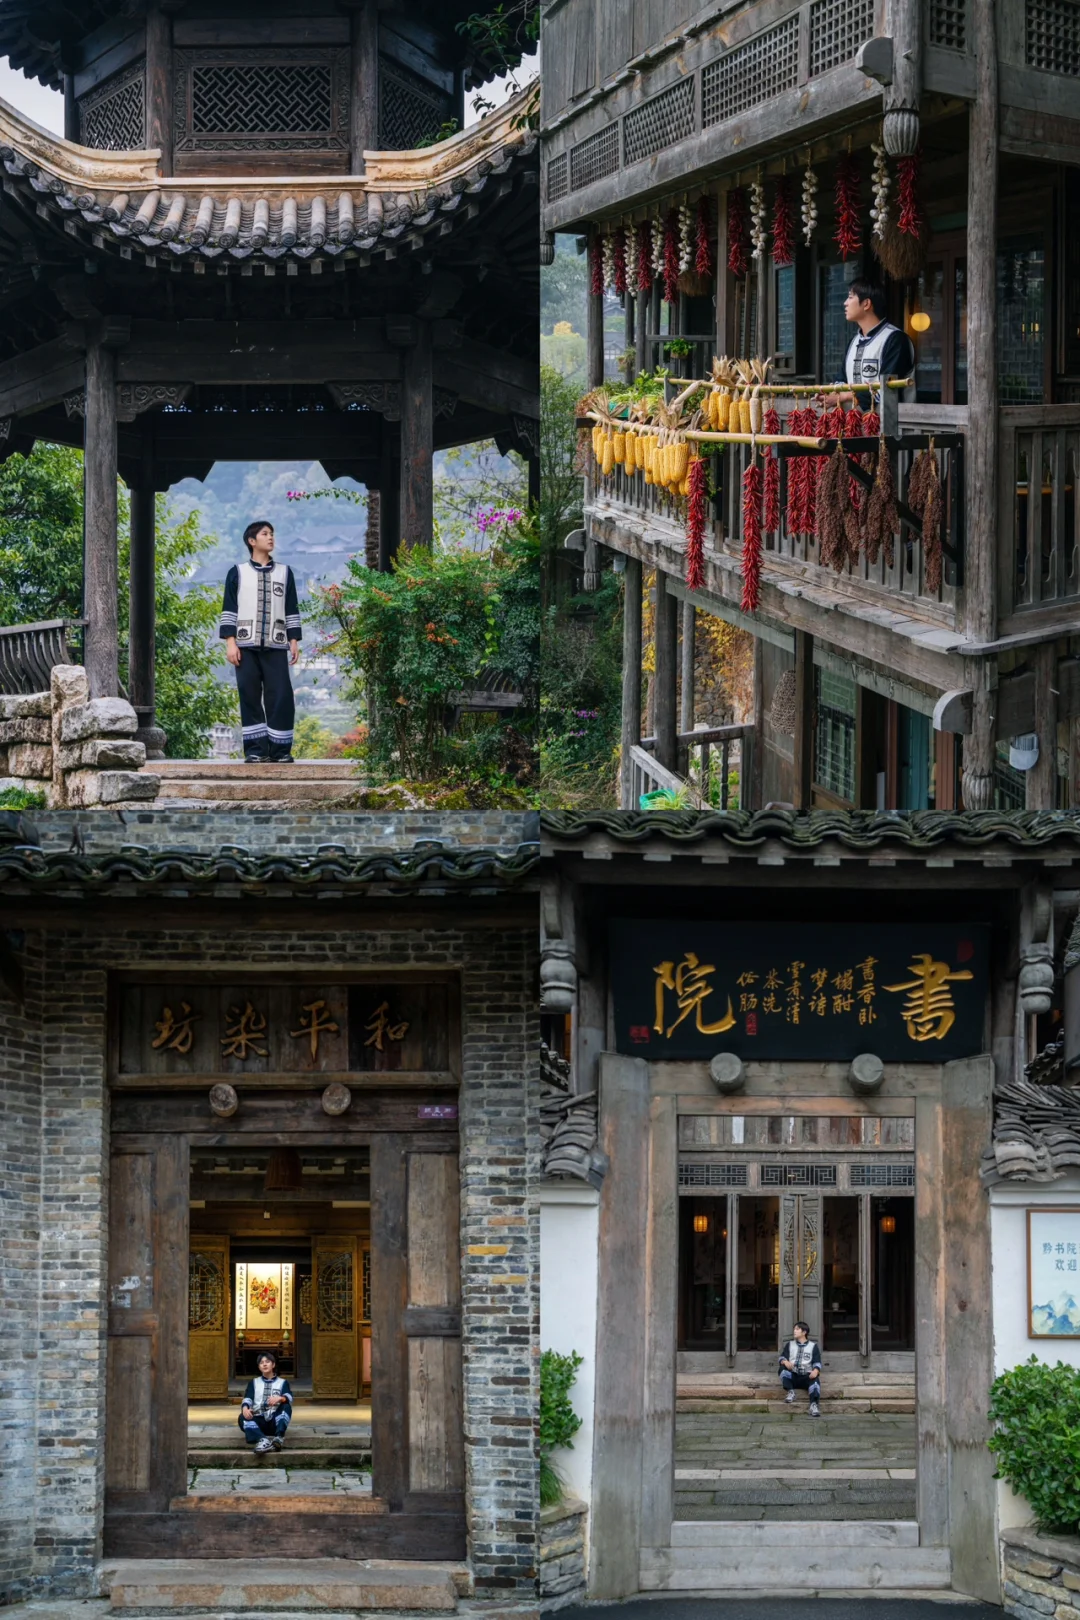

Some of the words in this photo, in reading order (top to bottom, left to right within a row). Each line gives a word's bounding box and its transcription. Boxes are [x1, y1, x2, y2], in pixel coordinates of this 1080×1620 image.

[152, 1000, 410, 1063] 和平染坊
[1042, 1242, 1080, 1255] 黔书院
[1055, 1259, 1080, 1271] 欢迎
